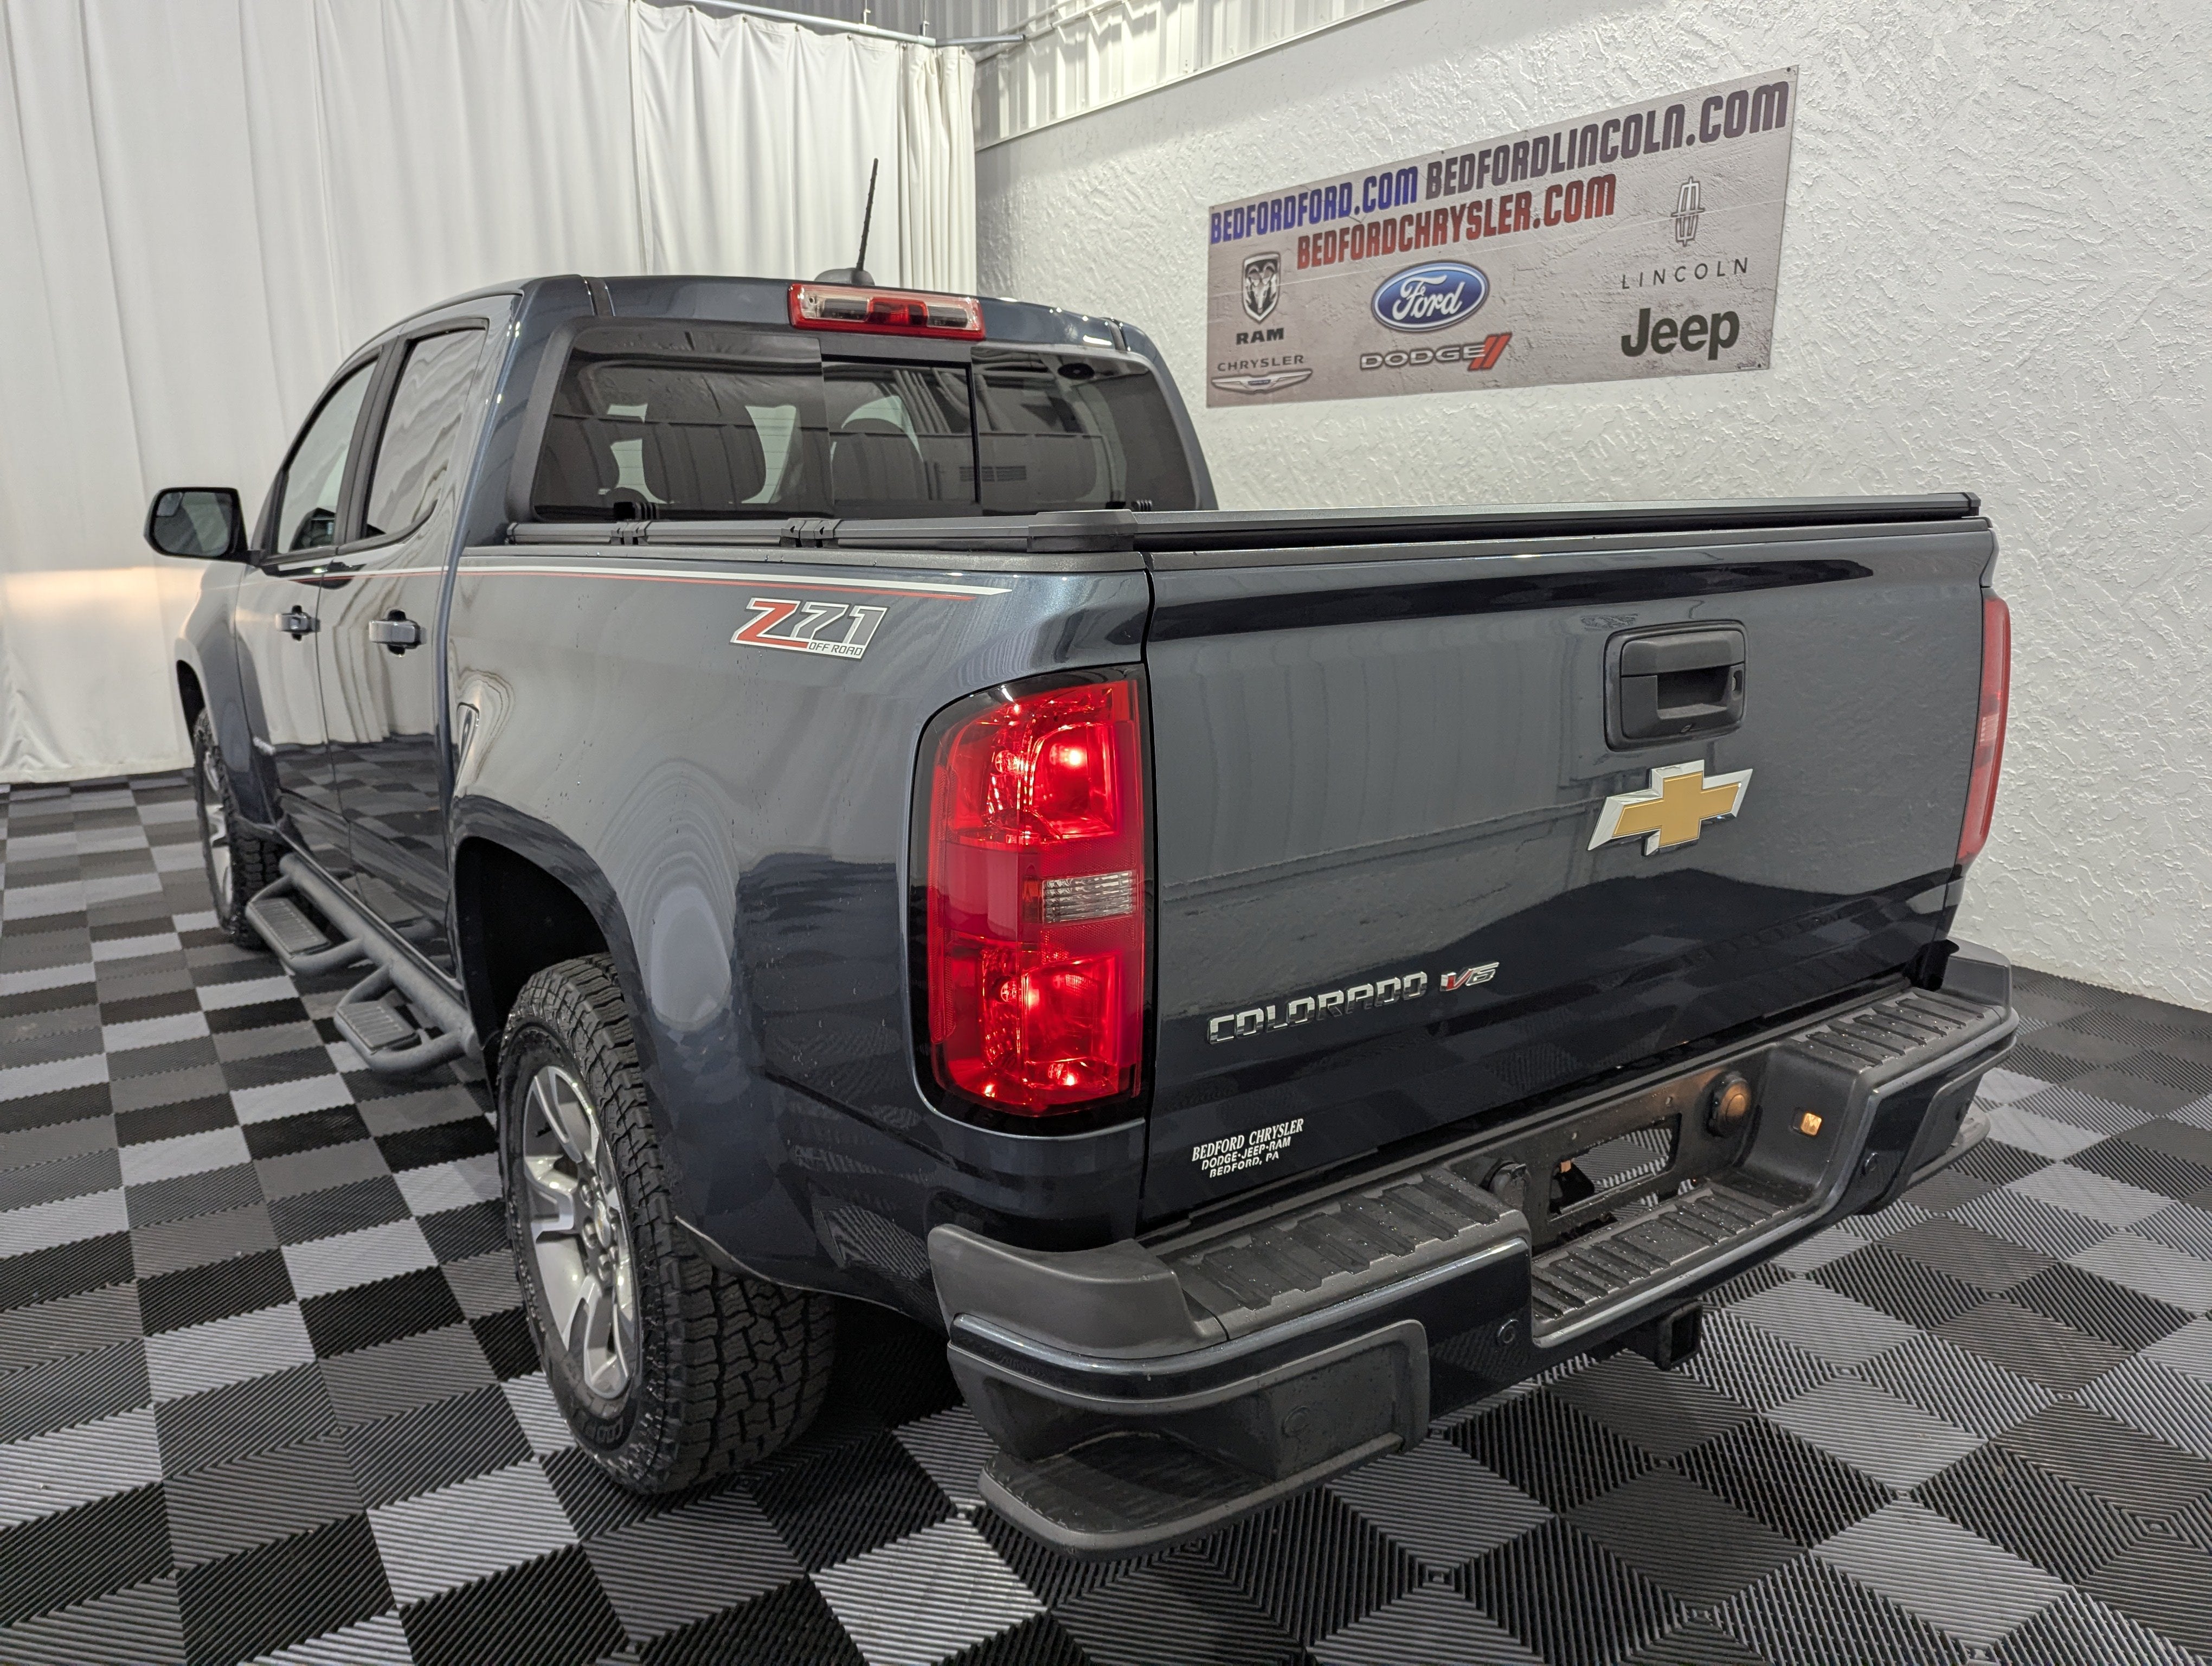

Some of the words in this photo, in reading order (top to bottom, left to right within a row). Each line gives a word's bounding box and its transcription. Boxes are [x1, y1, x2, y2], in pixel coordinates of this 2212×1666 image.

[1211, 166, 1418, 244] BEDFORDFORD.COM
[1426, 81, 1789, 200] BEDFORDLINCOLN.COM
[1297, 173, 1616, 270] BEDFORDCHRYSLER.COM
[1622, 257, 1748, 290] LINCOLN
[1392, 274, 1465, 321] Ford
[1236, 327, 1284, 345] RAM
[1621, 307, 1740, 361] Jeep
[1217, 354, 1304, 372] CHRYSLER
[1360, 343, 1487, 370] DODGE
[730, 596, 890, 652] Z71
[808, 642, 829, 652] OFF
[831, 644, 864, 656] ROAD
[1207, 971, 1428, 1045] COLORADO
[1439, 961, 1500, 992] V6
[1192, 1135, 1245, 1162] BEDFORD
[1249, 1118, 1304, 1145] CHRYSLER
[1209, 1156, 1263, 1178] BEDFORD,
[1265, 1151, 1279, 1162] PA
